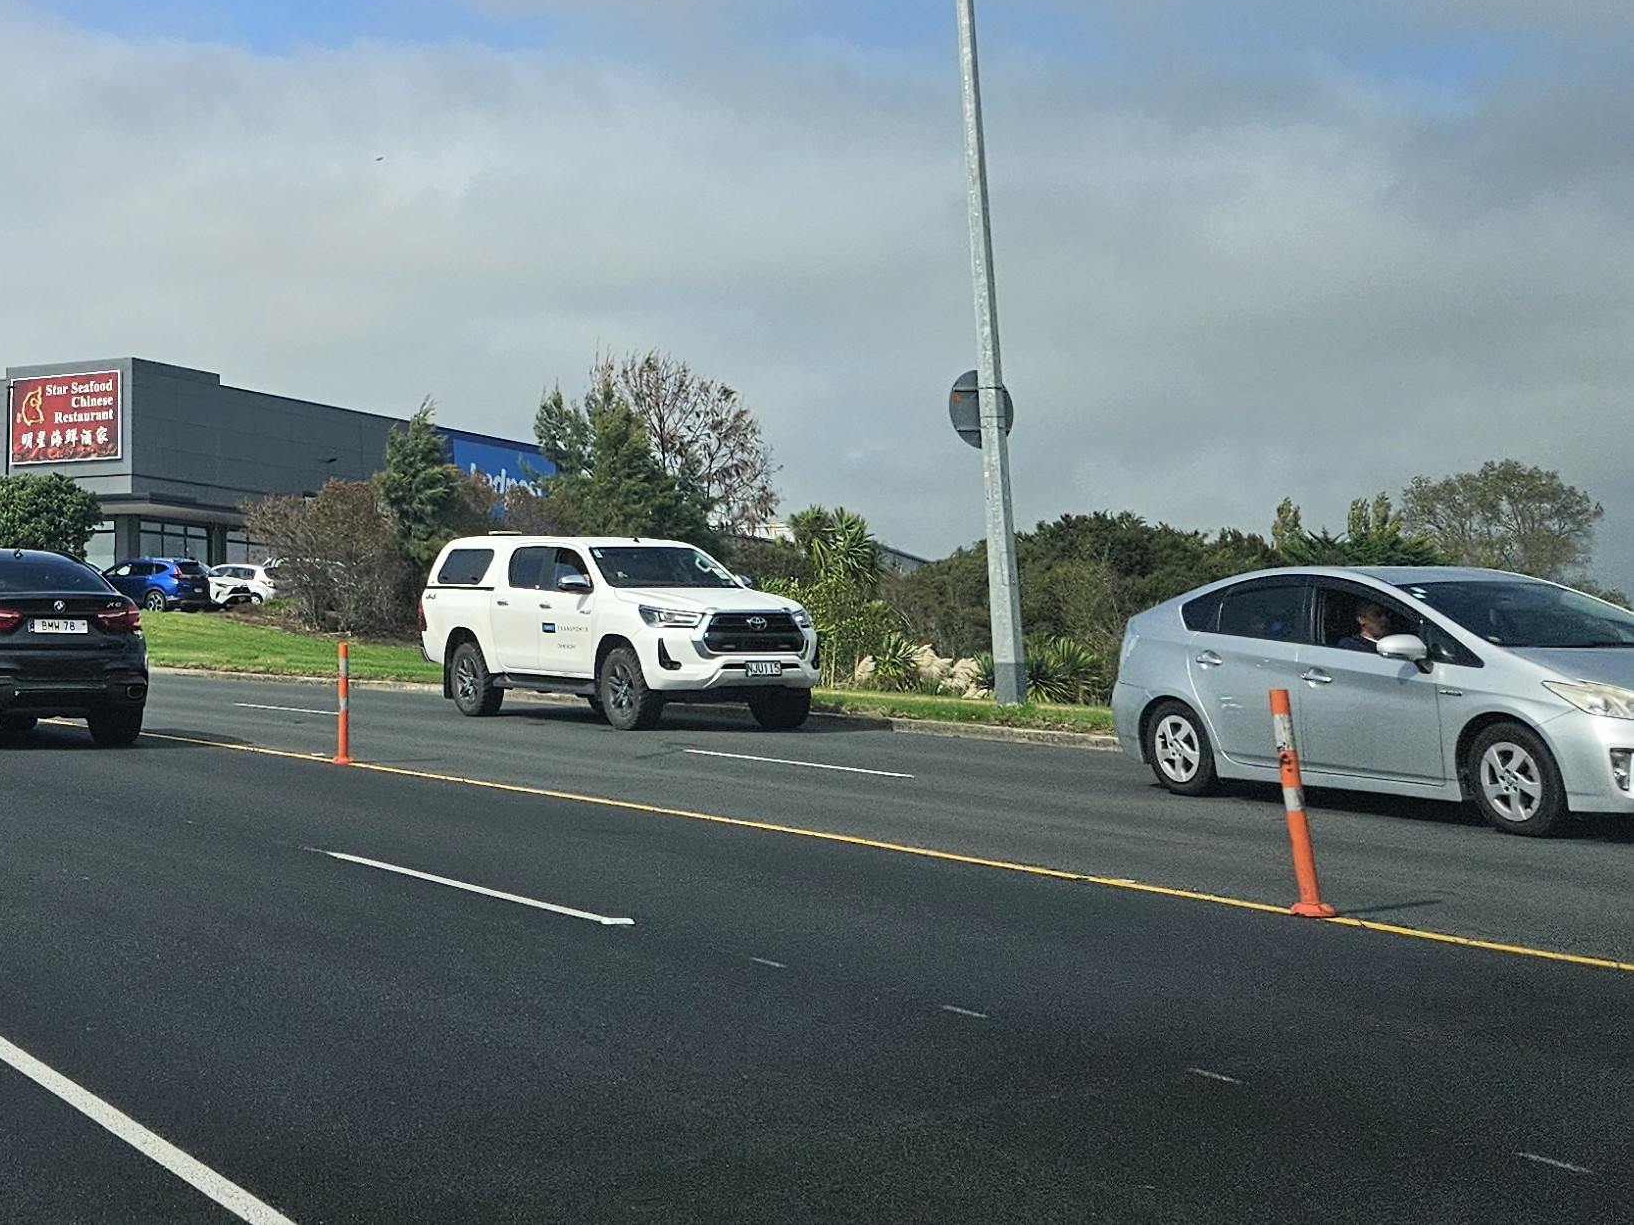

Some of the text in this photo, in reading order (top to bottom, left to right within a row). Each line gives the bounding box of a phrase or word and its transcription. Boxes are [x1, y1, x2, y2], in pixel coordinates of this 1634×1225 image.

[46, 379, 113, 396] Star Seafood
[71, 396, 113, 408] Chinese
[54, 409, 114, 424] Restaurant
[41, 620, 76, 631] BMW 78
